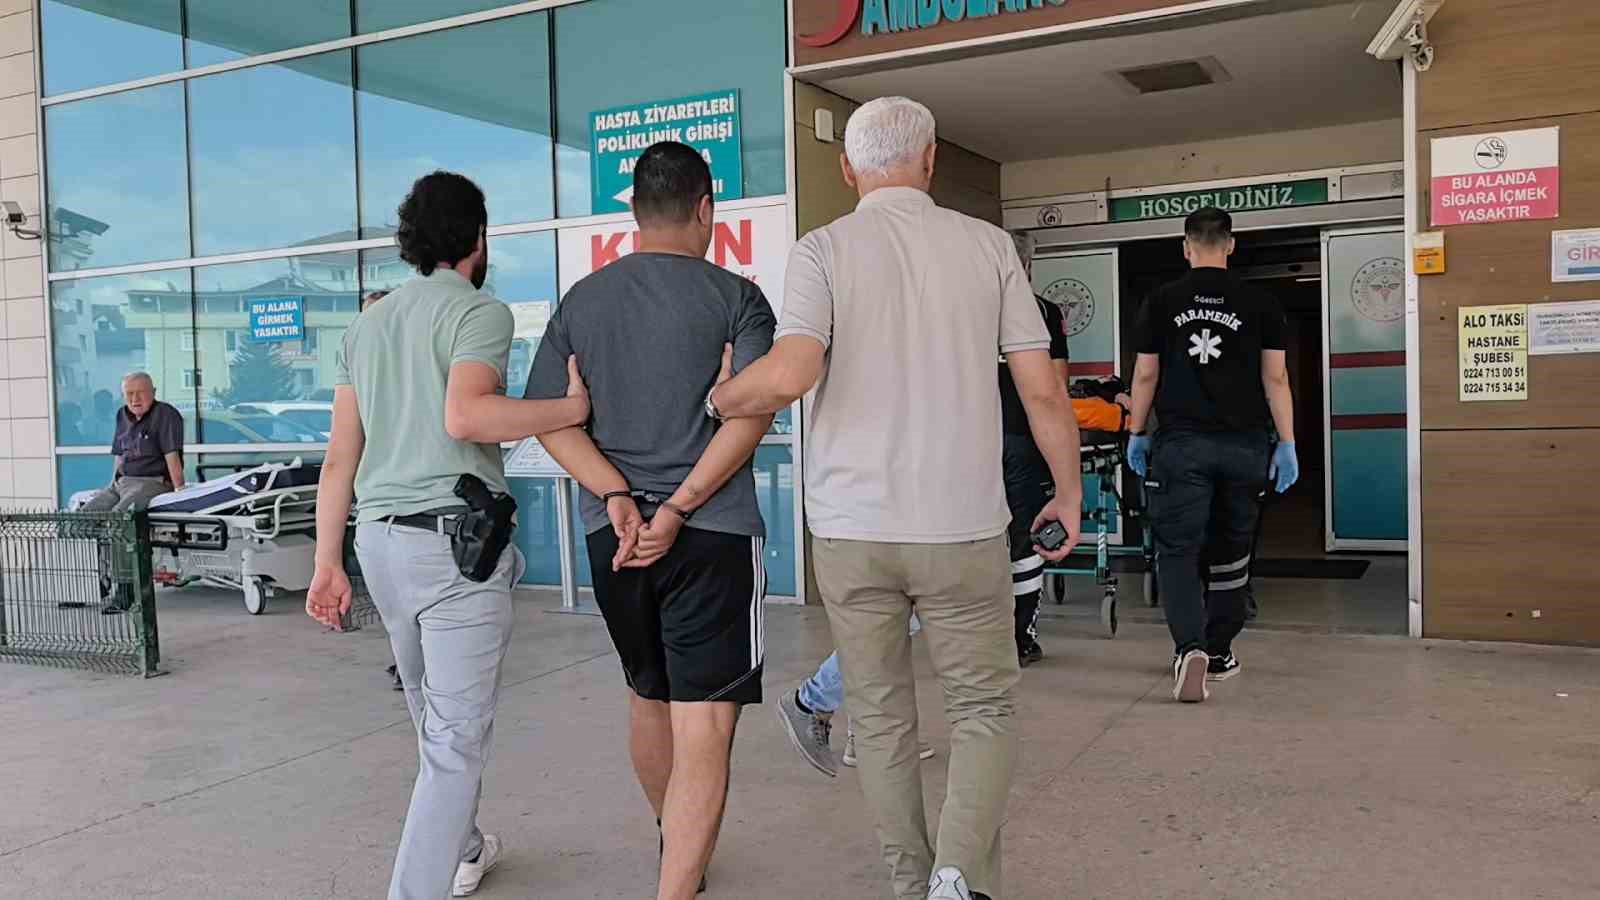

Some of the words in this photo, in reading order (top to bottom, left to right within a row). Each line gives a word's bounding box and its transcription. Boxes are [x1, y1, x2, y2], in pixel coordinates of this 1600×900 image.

[595, 110, 641, 131] HASTA
[643, 93, 735, 124] ZİYARETLERİ
[598, 125, 682, 153] POLİKLİNİK
[686, 117, 733, 142] GİRİŞİ
[1452, 177, 1472, 190] BU
[1475, 171, 1537, 187] ALANDA
[1441, 191, 1497, 208] SİGARA
[1500, 186, 1548, 205] İÇMEK
[1458, 205, 1530, 222] YASAKTIR
[267, 301, 298, 312] ALANA
[257, 313, 294, 325] GİRMEK
[1173, 308, 1243, 331] PARAMEDİK
[1463, 315, 1486, 328] ALO
[254, 325, 299, 337] YASAKTIR
[1468, 336, 1520, 348] HASTANE
[1463, 368, 1483, 378] 0224
[1486, 367, 1500, 378] 713
[1502, 367, 1512, 377] 00
[1515, 367, 1524, 377] 51
[1463, 383, 1483, 393] 0224
[1486, 383, 1500, 393] 715
[1502, 382, 1513, 393] 34
[1515, 382, 1525, 392] 34
